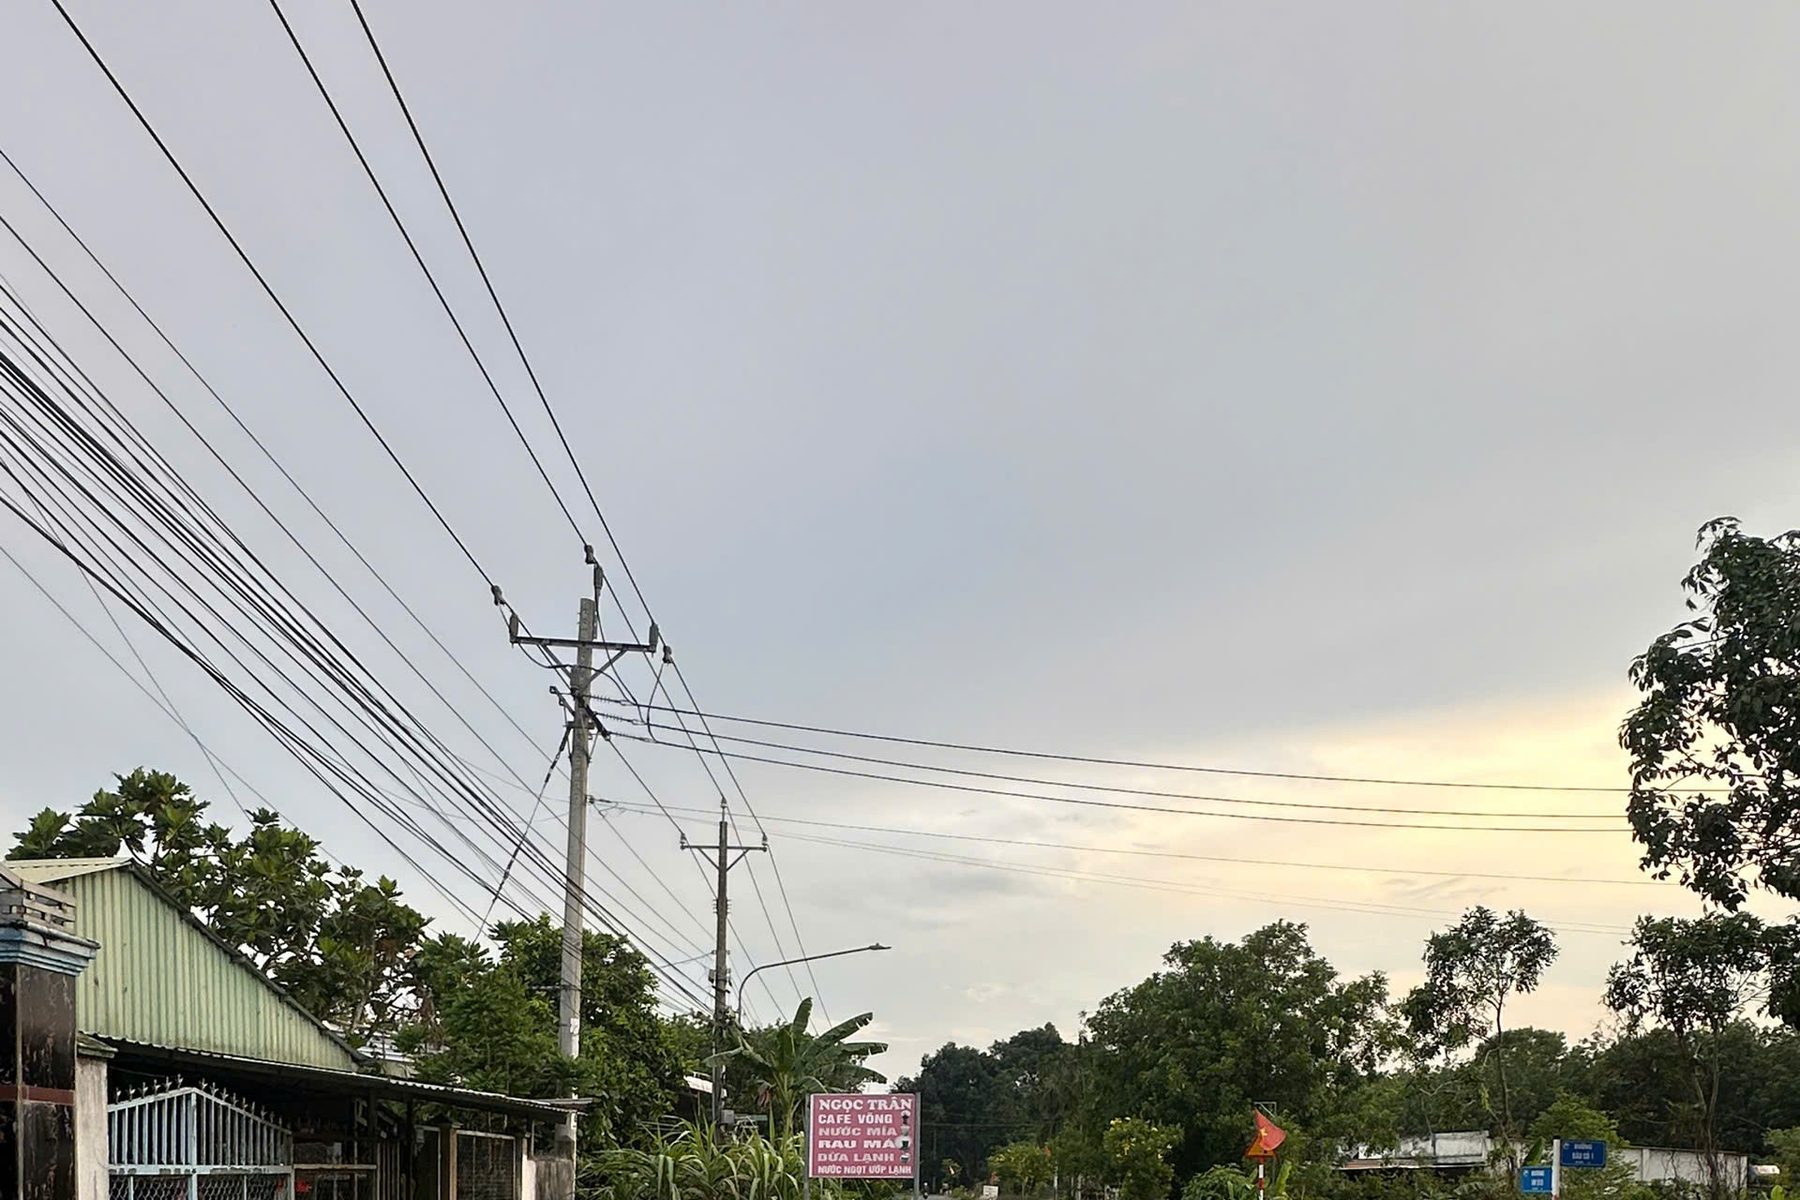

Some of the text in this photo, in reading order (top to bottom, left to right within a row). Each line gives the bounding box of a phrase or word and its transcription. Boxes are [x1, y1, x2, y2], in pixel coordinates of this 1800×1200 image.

[819, 1096, 912, 1113] NGỌC TRÂN
[857, 1112, 893, 1124] VÕNG
[818, 1125, 898, 1136] NƯỚC MÍA
[818, 1138, 895, 1149] RAU MÁ
[853, 1153, 894, 1163] LẠNH
[817, 1164, 842, 1174] NƯỚC
[844, 1165, 866, 1175] NGỌT
[888, 1165, 912, 1175] LẠNH
